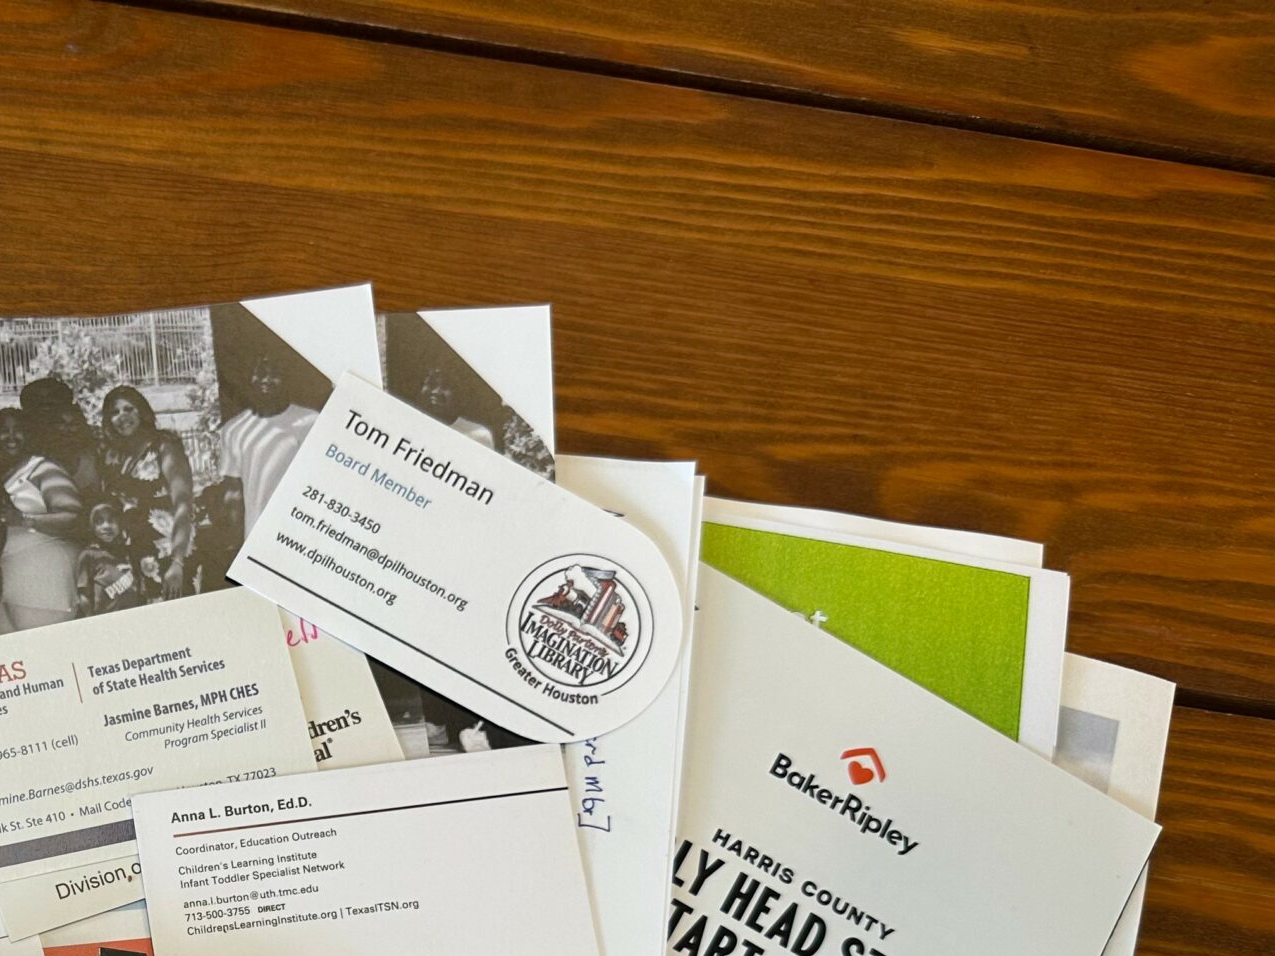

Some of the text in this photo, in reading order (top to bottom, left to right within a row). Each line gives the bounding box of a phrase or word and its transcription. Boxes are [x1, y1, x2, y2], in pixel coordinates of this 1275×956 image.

[345, 409, 494, 506] Tom Friedman
[324, 442, 433, 510] Board Member
[302, 486, 381, 535] 281-830-3450
[276, 530, 397, 606] www.dpilhouston.org
[290, 507, 468, 611] tom.friedman@dpilhouston.org
[86, 647, 193, 678] Texas Department
[520, 611, 619, 678] IMAGINATION
[92, 659, 226, 696] of State Health Services
[505, 647, 598, 705] Greater Houston
[526, 640, 594, 686] LIBRARY
[0, 684, 21, 700] and
[22, 678, 65, 696] Human
[103, 682, 260, 728] Jasmine Barnes, MPH CHES
[51, 733, 79, 751] (cell)
[124, 706, 263, 742] Community Health Services
[164, 718, 267, 750] Program Specialist II
[170, 796, 312, 824] Anna L. Burton, Ed.D.
[769, 753, 919, 855] BakerRipley
[175, 827, 338, 856] Coordinator, Education Outreach
[177, 851, 318, 876] Children's Learning Institute
[180, 860, 346, 889] Infant Toddler Specialist Network
[183, 884, 319, 909] anna.l.burton@uth.tmc.edu
[712, 828, 795, 885] HARRIS
[800, 880, 896, 941] COUNTY
[184, 903, 286, 923] 713-500-3755 DIRECT
[186, 900, 420, 936] ChildrensLearningInstitute.org TexasITSN.org
